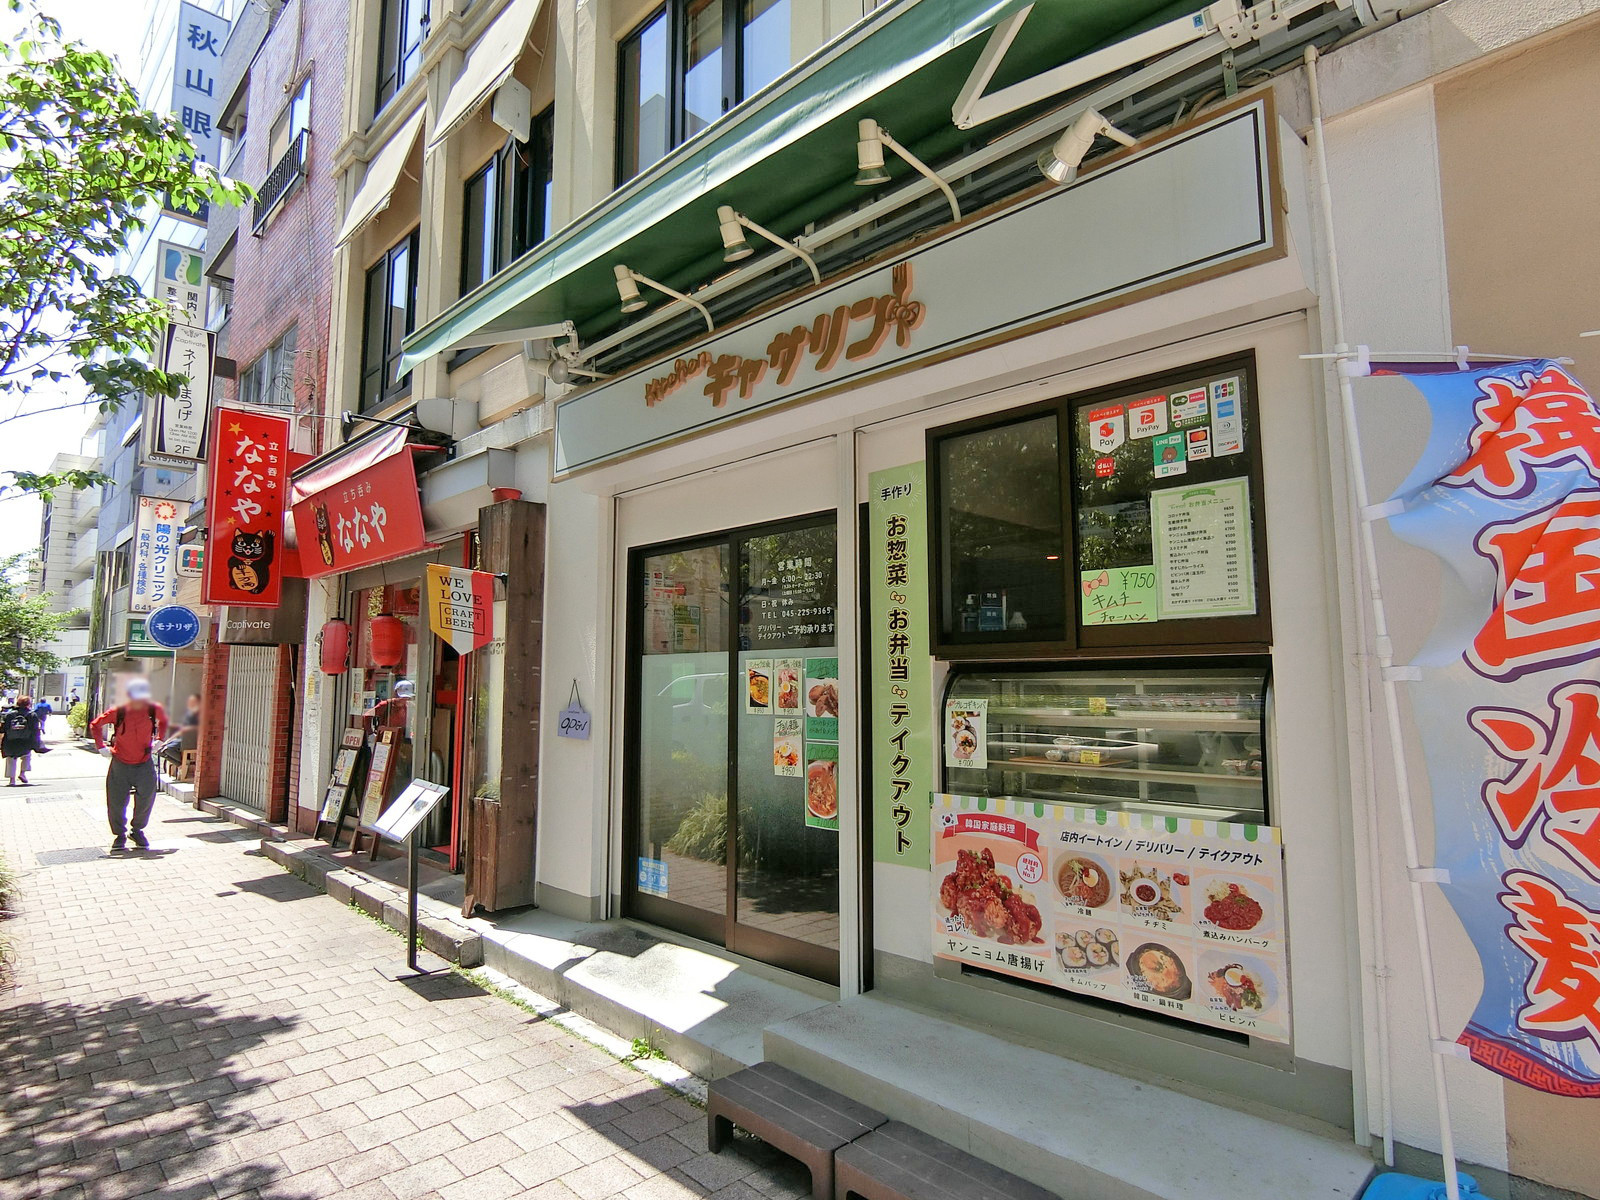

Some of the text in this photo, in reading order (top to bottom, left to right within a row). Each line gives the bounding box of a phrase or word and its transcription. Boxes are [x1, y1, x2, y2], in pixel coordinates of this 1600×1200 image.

[174, 337, 206, 348] Captivate
[704, 294, 898, 408] キャサリン
[1136, 423, 1160, 434] PayPay
[1099, 437, 1115, 447] Pay
[1155, 438, 1168, 446] LINE
[174, 444, 191, 454] 2F
[1193, 447, 1207, 455] VISA
[267, 441, 279, 489] 立ち呑み
[231, 435, 266, 524] ななや
[342, 481, 372, 504] 立ち呑み
[880, 483, 912, 501] 手作り
[141, 497, 153, 508] 3F
[1188, 497, 1231, 508] お弁当メニュー
[337, 502, 387, 553] ななや
[152, 523, 171, 602] 陽の光クリニック
[439, 575, 464, 589] WE
[1120, 571, 1155, 590] ¥750
[441, 589, 483, 605] LOVE
[1092, 591, 1130, 608] キムチ
[444, 607, 482, 620] CRAFT
[762, 606, 831, 619] TEL 045-225-9365
[1101, 611, 1147, 623] チャーハン
[155, 622, 193, 632] モナリザ
[226, 619, 271, 629] Captivate
[445, 617, 475, 629] BEER
[787, 623, 835, 635] ご予約承ります
[758, 632, 786, 640] テイクアウト
[887, 516, 911, 853] お惣菜 お弁当 テイクアウト
[345, 735, 361, 745] OPEN
[965, 818, 1016, 834] 韓国家庭料理
[1060, 831, 1122, 848] 店内イートイン
[1135, 840, 1185, 855] デリバリー
[1199, 849, 1263, 866] テイクアウト
[1022, 870, 1036, 880] No.1
[1144, 920, 1167, 930] チヂミ
[1203, 930, 1269, 948] 煮込みハンバーグ
[947, 939, 1045, 973] ヤンニョム唐揚げ
[1133, 992, 1184, 1011] 韓国・鍋料理
